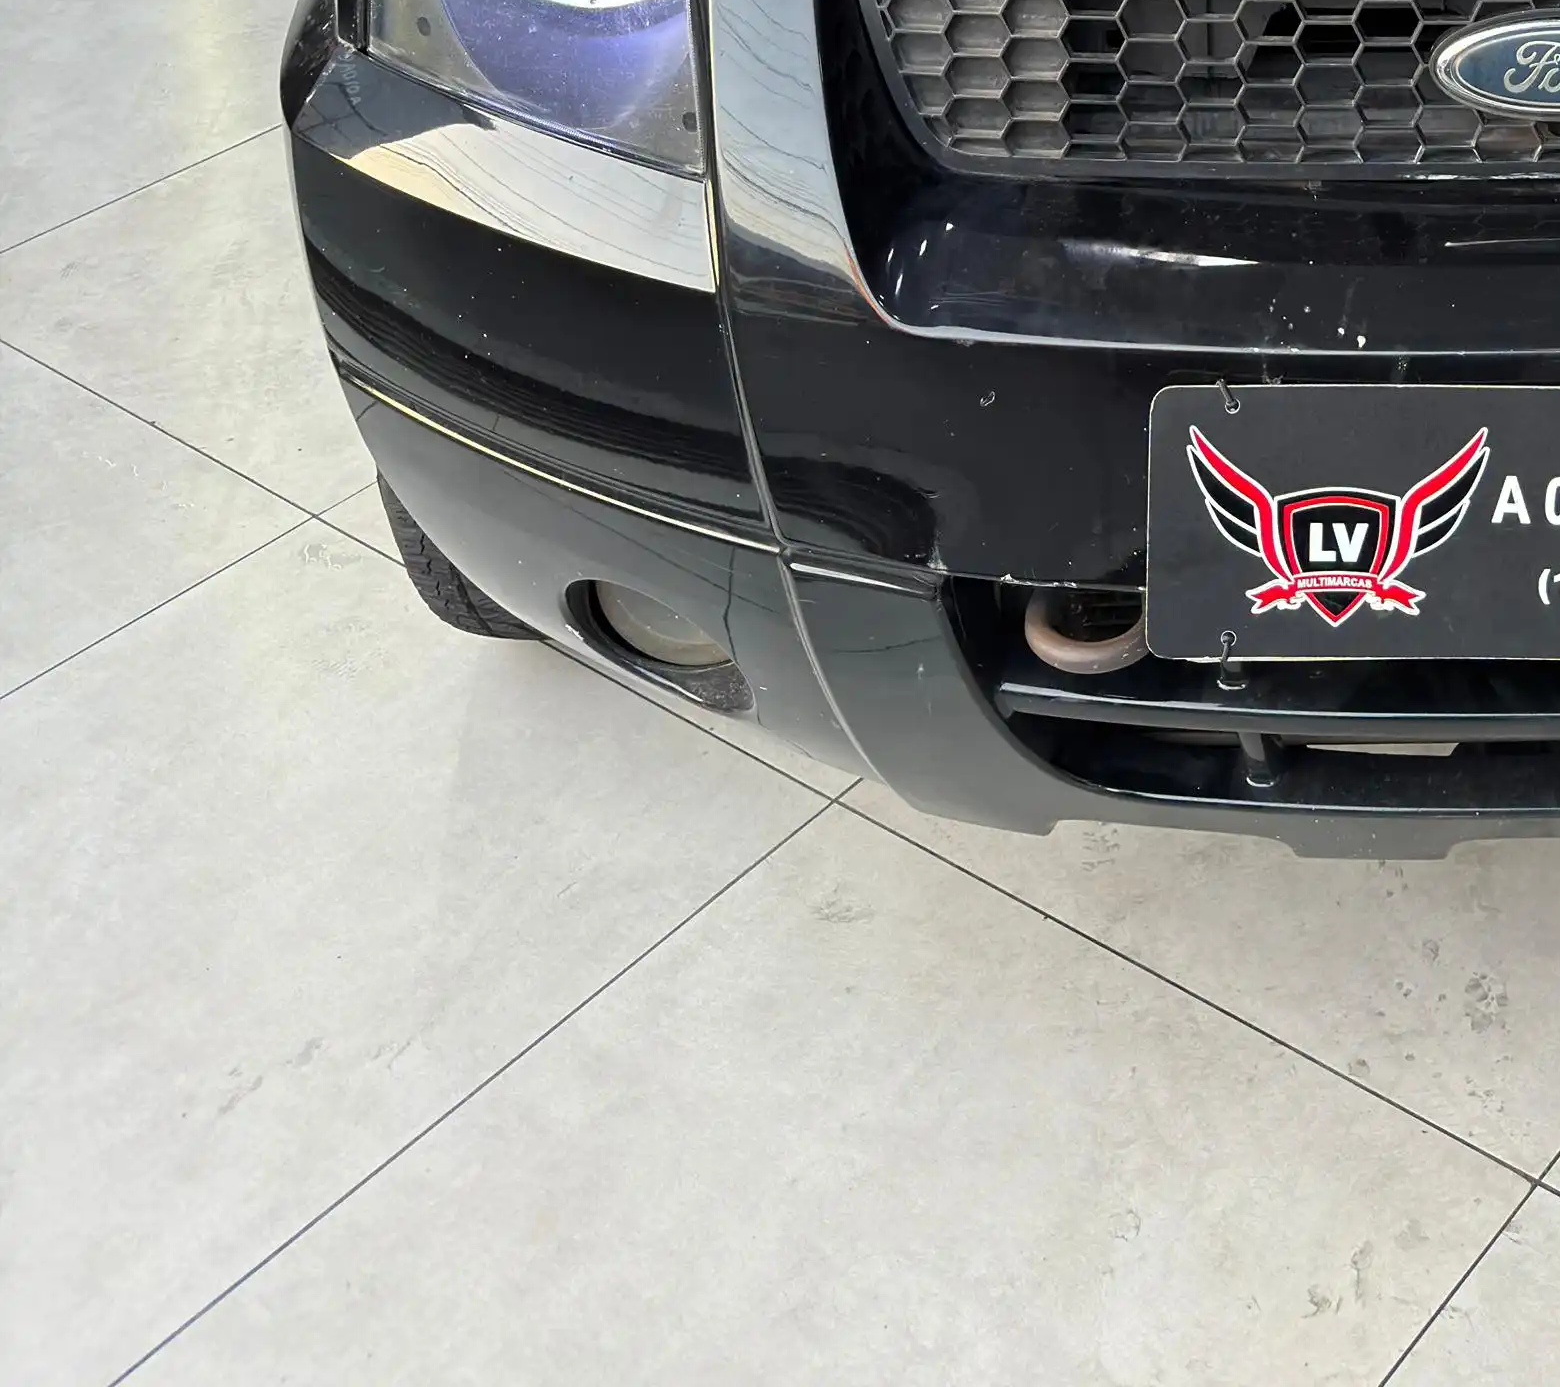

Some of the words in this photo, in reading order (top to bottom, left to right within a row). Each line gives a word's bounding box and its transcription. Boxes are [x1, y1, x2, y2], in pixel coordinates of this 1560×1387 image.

[1491, 475, 1529, 525] A
[1308, 522, 1369, 562] LV
[1297, 575, 1373, 589] MULTIMARCAS
